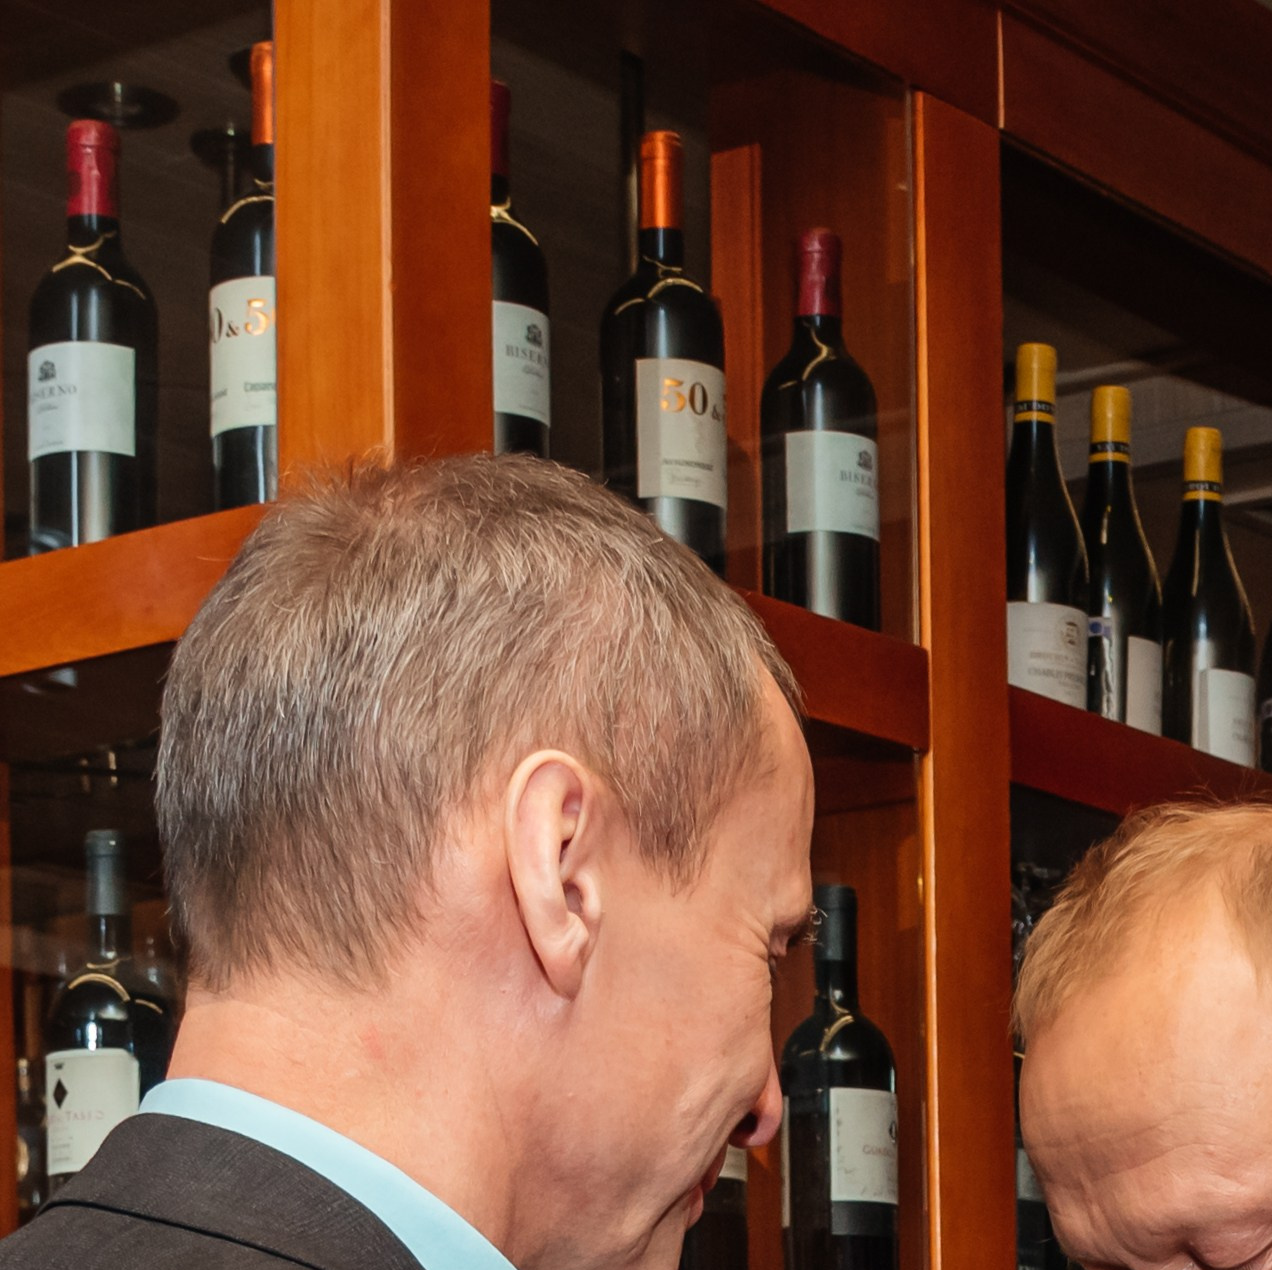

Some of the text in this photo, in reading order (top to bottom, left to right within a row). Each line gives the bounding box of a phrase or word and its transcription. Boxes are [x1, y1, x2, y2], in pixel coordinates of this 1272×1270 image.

[226, 321, 240, 338] &
[245, 298, 275, 336] 5
[660, 377, 708, 415] 50
